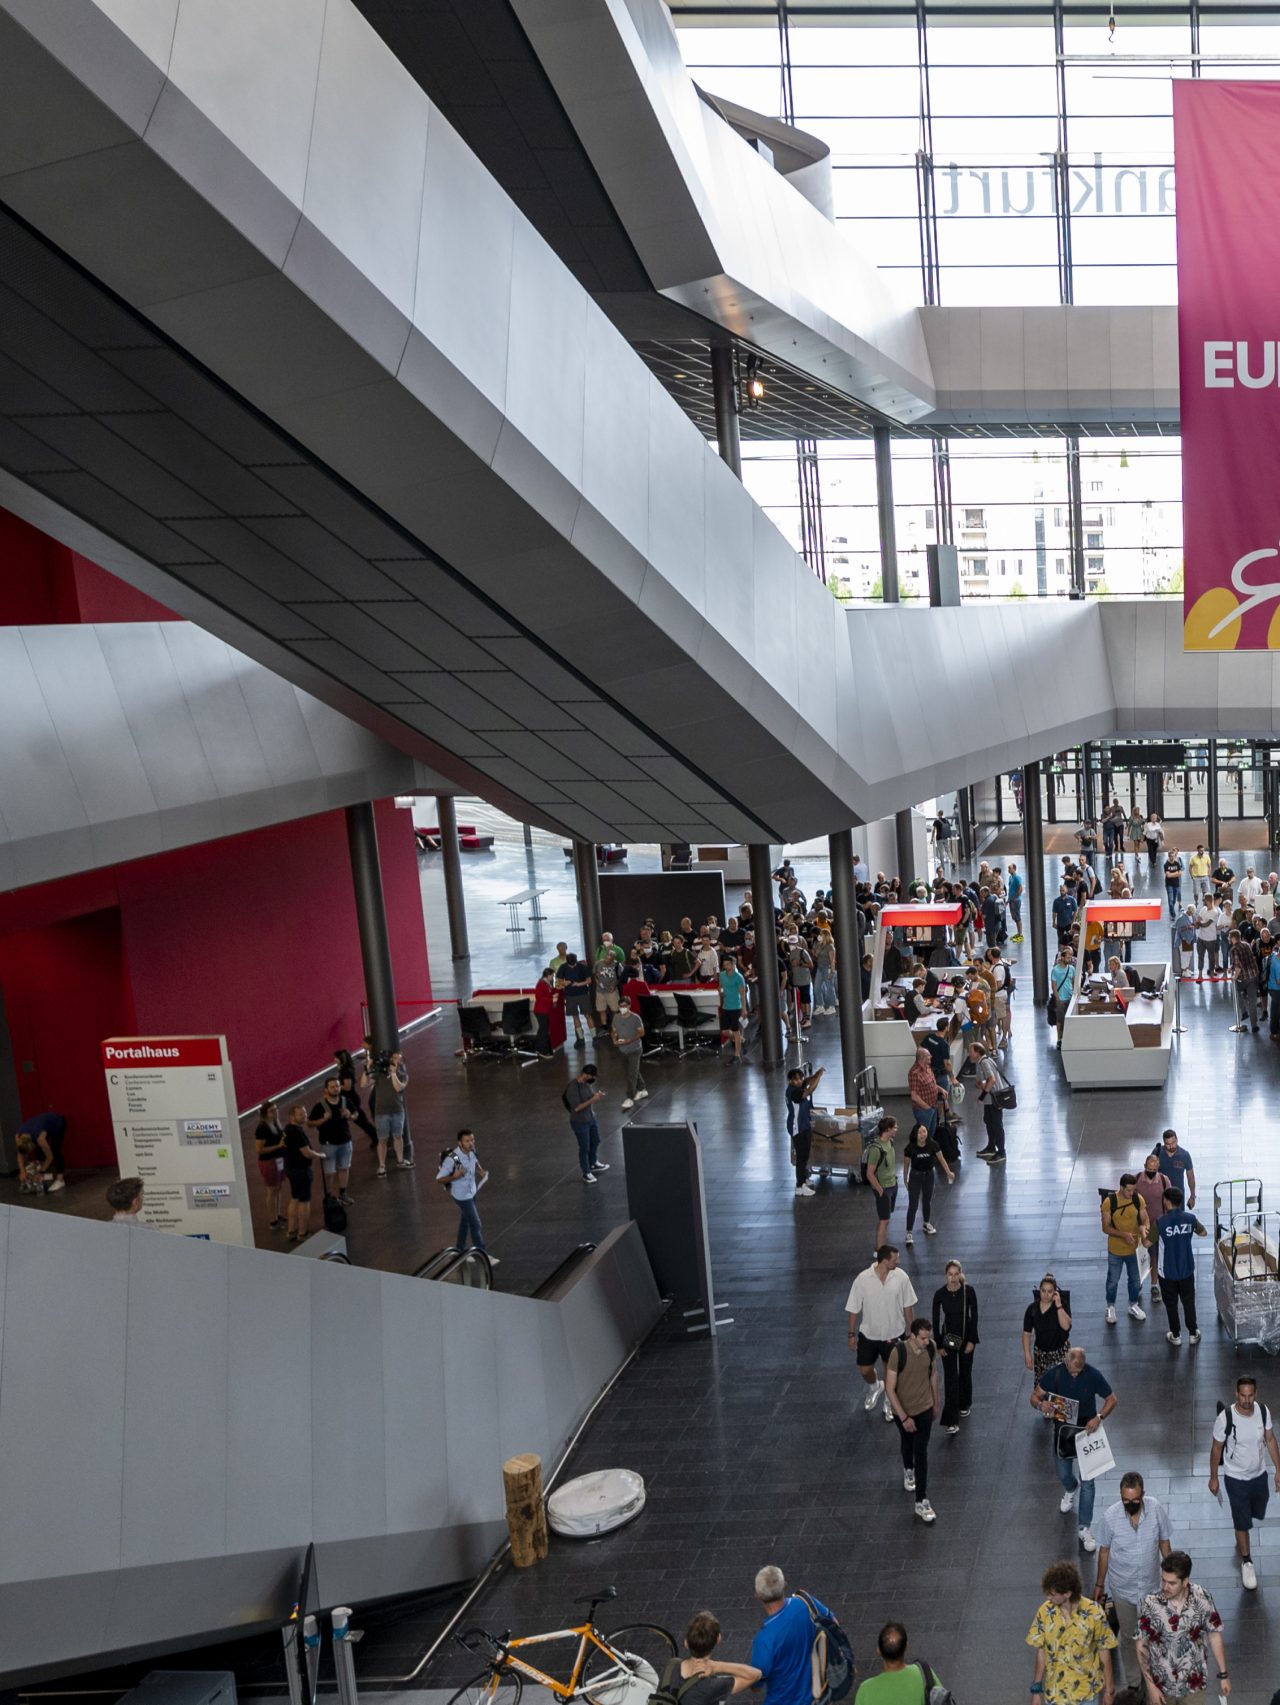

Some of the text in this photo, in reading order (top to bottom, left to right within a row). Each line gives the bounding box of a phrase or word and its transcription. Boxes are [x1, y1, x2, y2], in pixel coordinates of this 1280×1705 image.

[105, 1046, 180, 1060] Portalhaus
[110, 1075, 119, 1085] C
[123, 1127, 128, 1137] 1
[1083, 1440, 1101, 1456] SAZ
